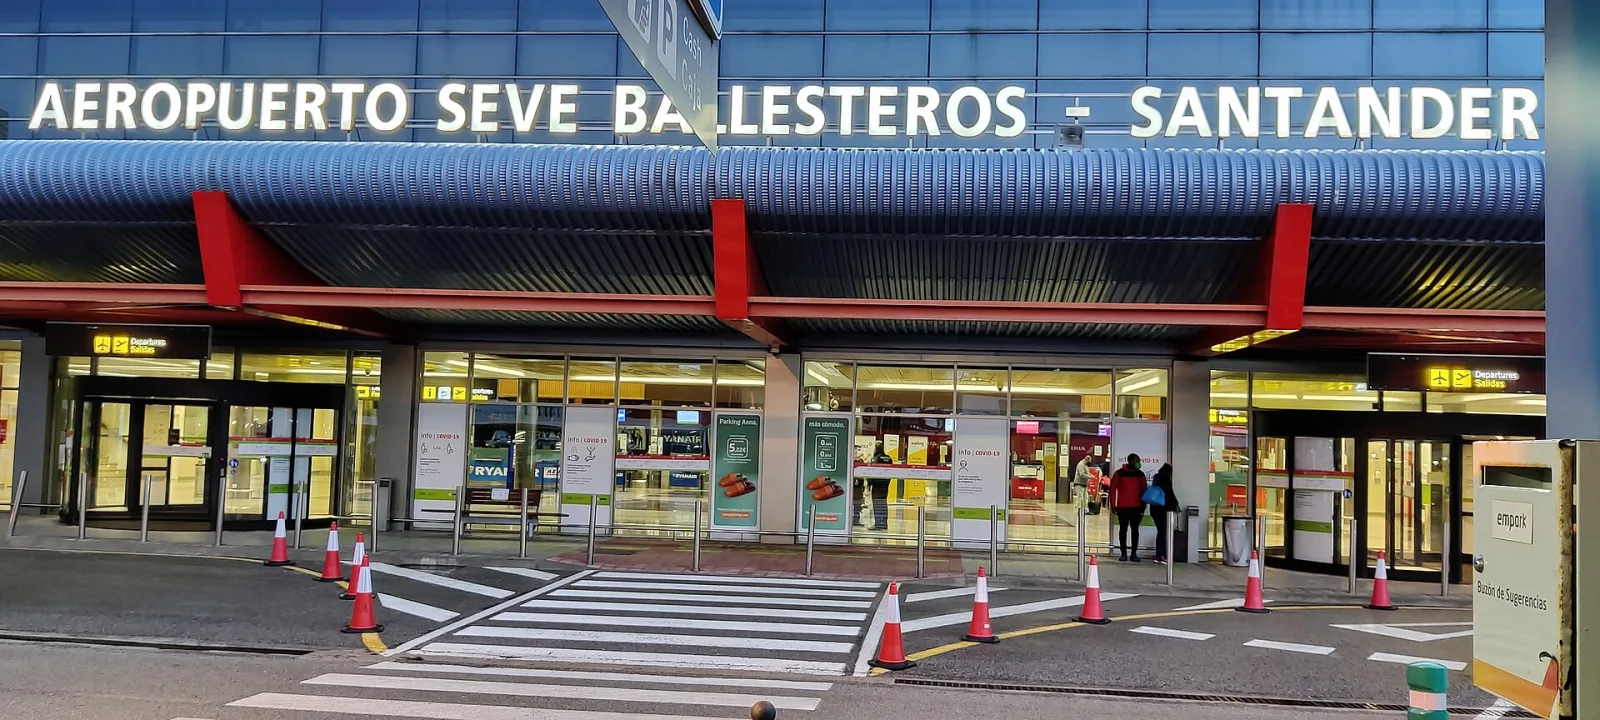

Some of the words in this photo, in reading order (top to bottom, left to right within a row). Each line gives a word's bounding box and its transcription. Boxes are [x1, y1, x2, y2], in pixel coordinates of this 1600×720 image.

[683, 16, 702, 67] Cash
[682, 58, 702, 112] Caja
[28, 82, 408, 132] AEROPUERTO
[436, 82, 579, 133] SEVE
[614, 84, 1028, 138] BALESTEROS
[1130, 86, 1540, 141] SANTANDER
[131, 337, 167, 347] Departures
[131, 346, 156, 354] Salidas
[1475, 370, 1519, 381] Departures
[1475, 379, 1505, 388] Salidas
[719, 418, 741, 426] Parking
[1497, 513, 1526, 531] empark
[1477, 580, 1496, 598] Buzón
[1496, 585, 1505, 599] de
[1506, 589, 1547, 611] Sugerencias
